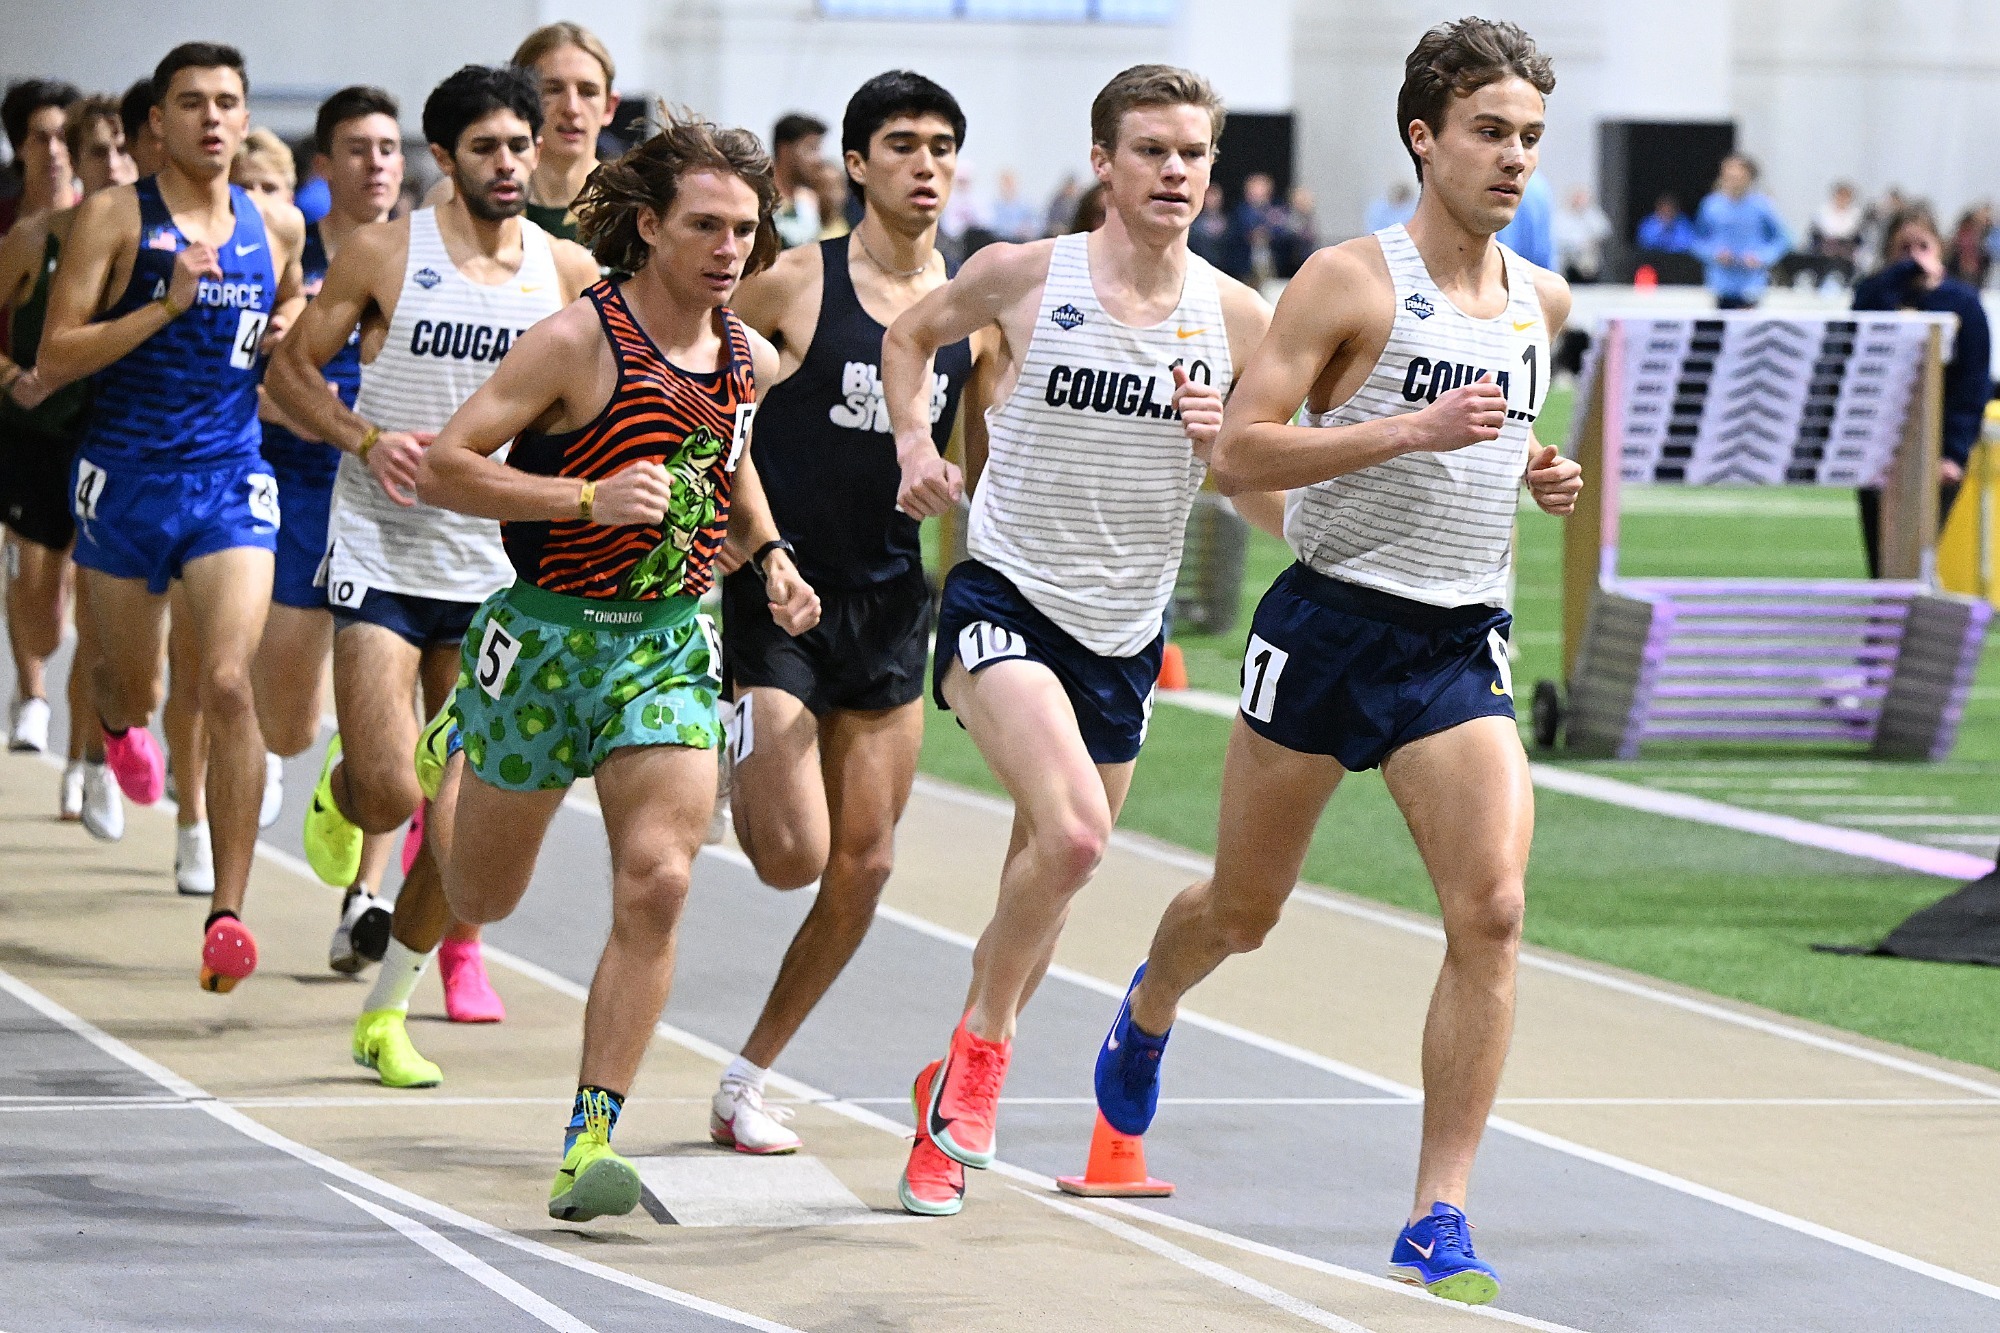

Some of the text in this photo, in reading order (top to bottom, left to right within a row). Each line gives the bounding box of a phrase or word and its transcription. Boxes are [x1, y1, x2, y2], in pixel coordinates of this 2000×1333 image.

[198, 281, 263, 310] FORCE
[1053, 310, 1084, 325] RMAC
[241, 318, 260, 365] 4
[410, 319, 528, 363] COUGA
[842, 361, 949, 410] BLK
[1045, 364, 1182, 421] COUGA
[1521, 344, 1536, 411] 1
[79, 469, 97, 516] 4
[479, 628, 512, 688] 5
[968, 622, 1013, 660] 10
[1248, 649, 1273, 714] 1
